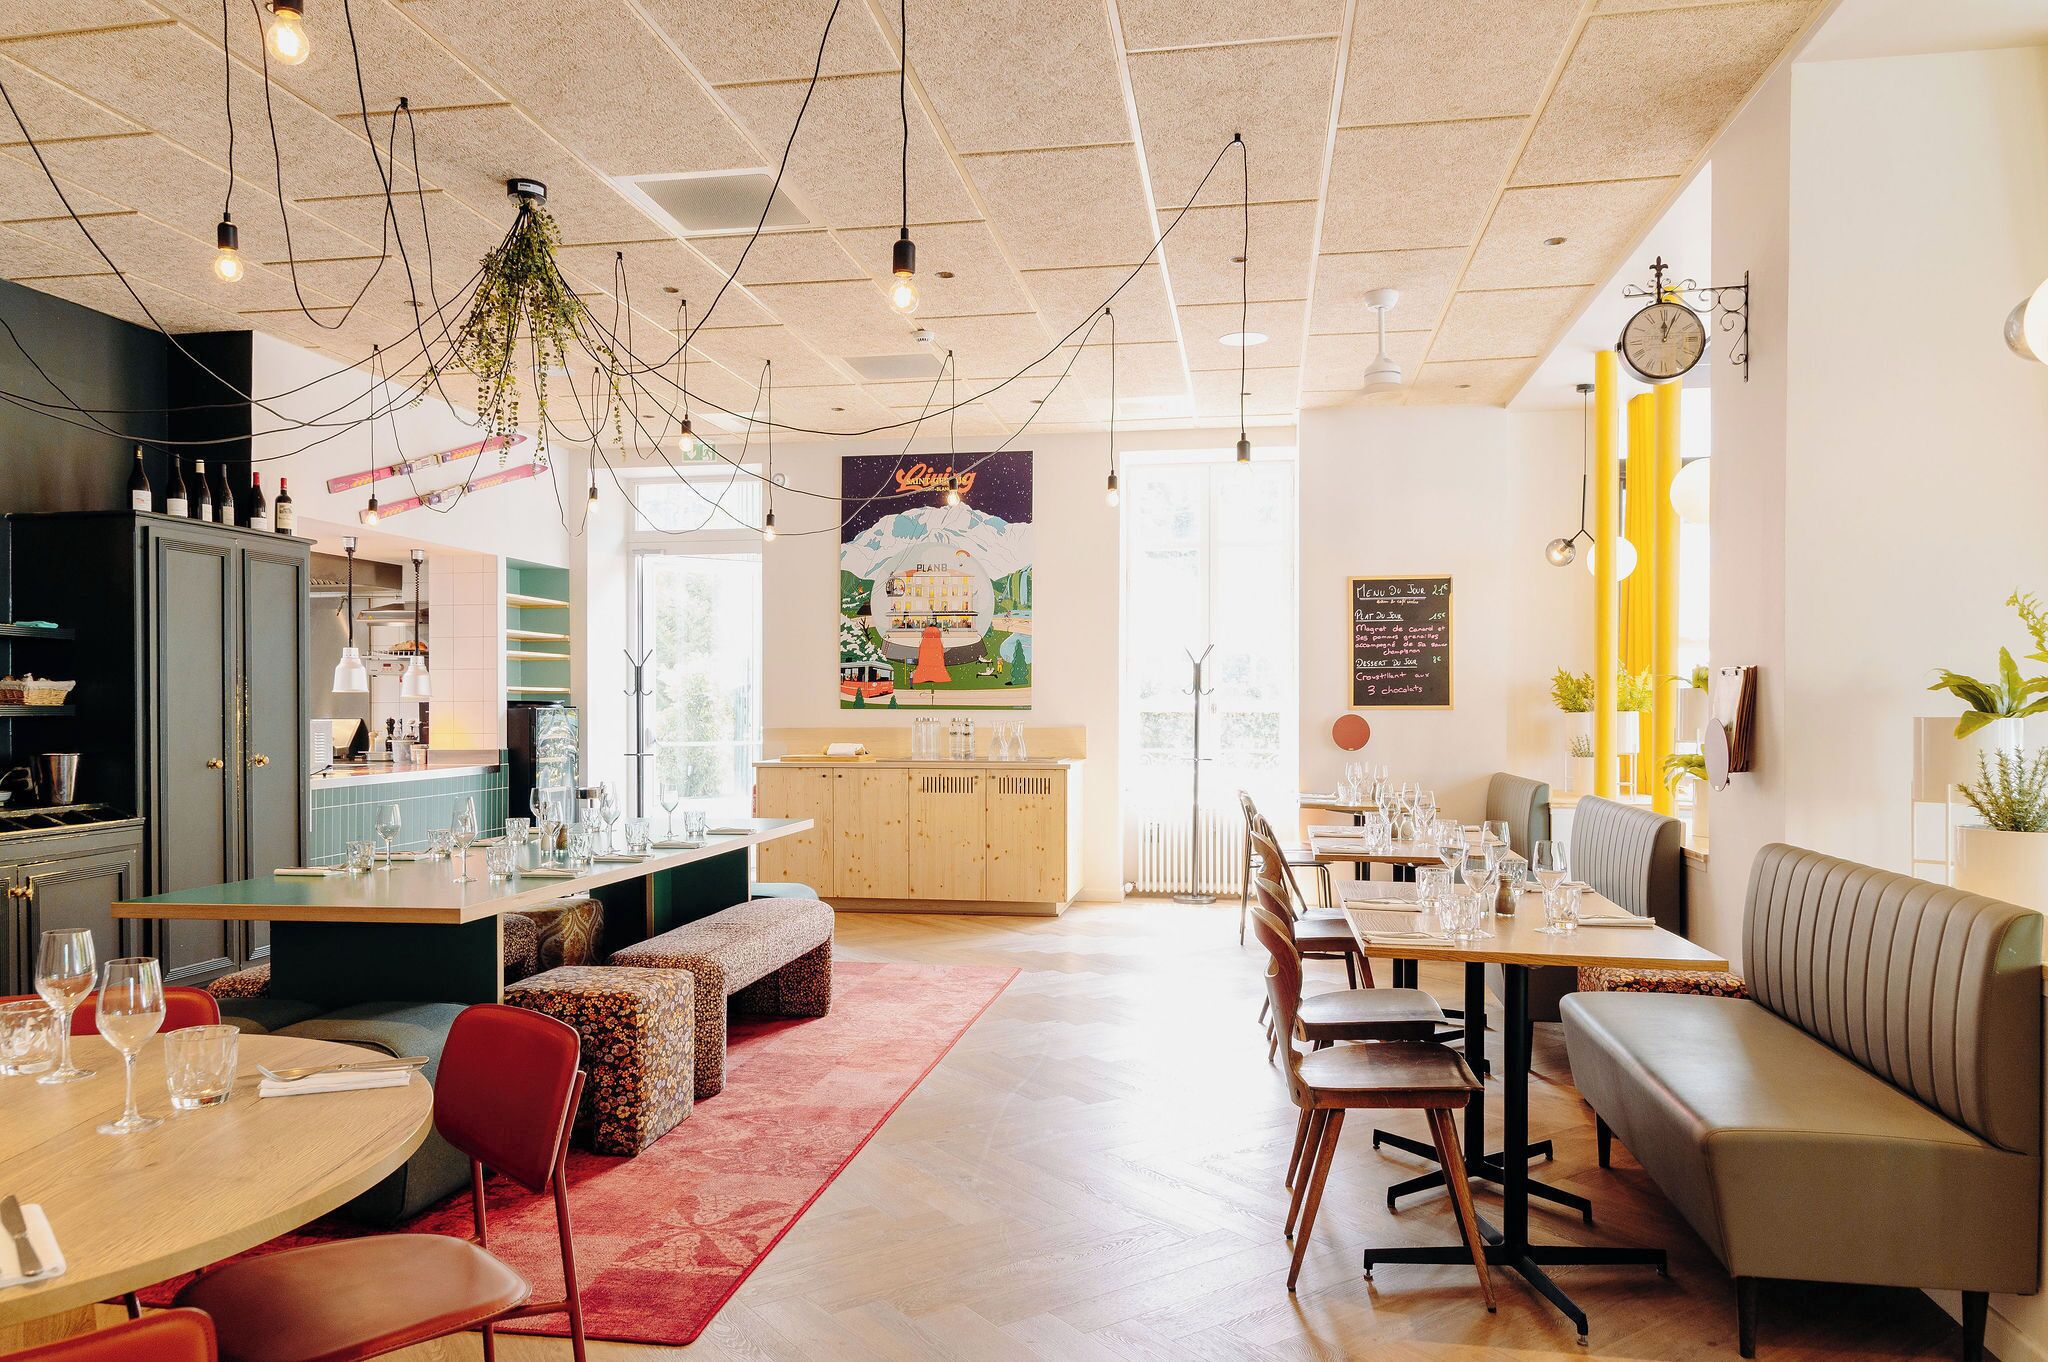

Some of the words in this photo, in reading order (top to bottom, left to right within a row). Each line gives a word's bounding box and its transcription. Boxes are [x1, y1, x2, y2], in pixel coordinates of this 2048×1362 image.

[1356, 584, 1385, 598] MENU
[1388, 585, 1402, 596] DU
[1407, 583, 1426, 594] JOUR
[1354, 608, 1374, 620] PLAT
[1386, 612, 1403, 620] JOUR
[1355, 624, 1386, 634] Magret
[1392, 624, 1403, 632] de
[1356, 658, 1388, 666] DESSERT
[1392, 658, 1400, 666] DU
[1404, 658, 1418, 666] JOUR
[1356, 672, 1407, 680] Croustillant
[1368, 685, 1376, 696] 3
[1381, 684, 1424, 695] chocolats
